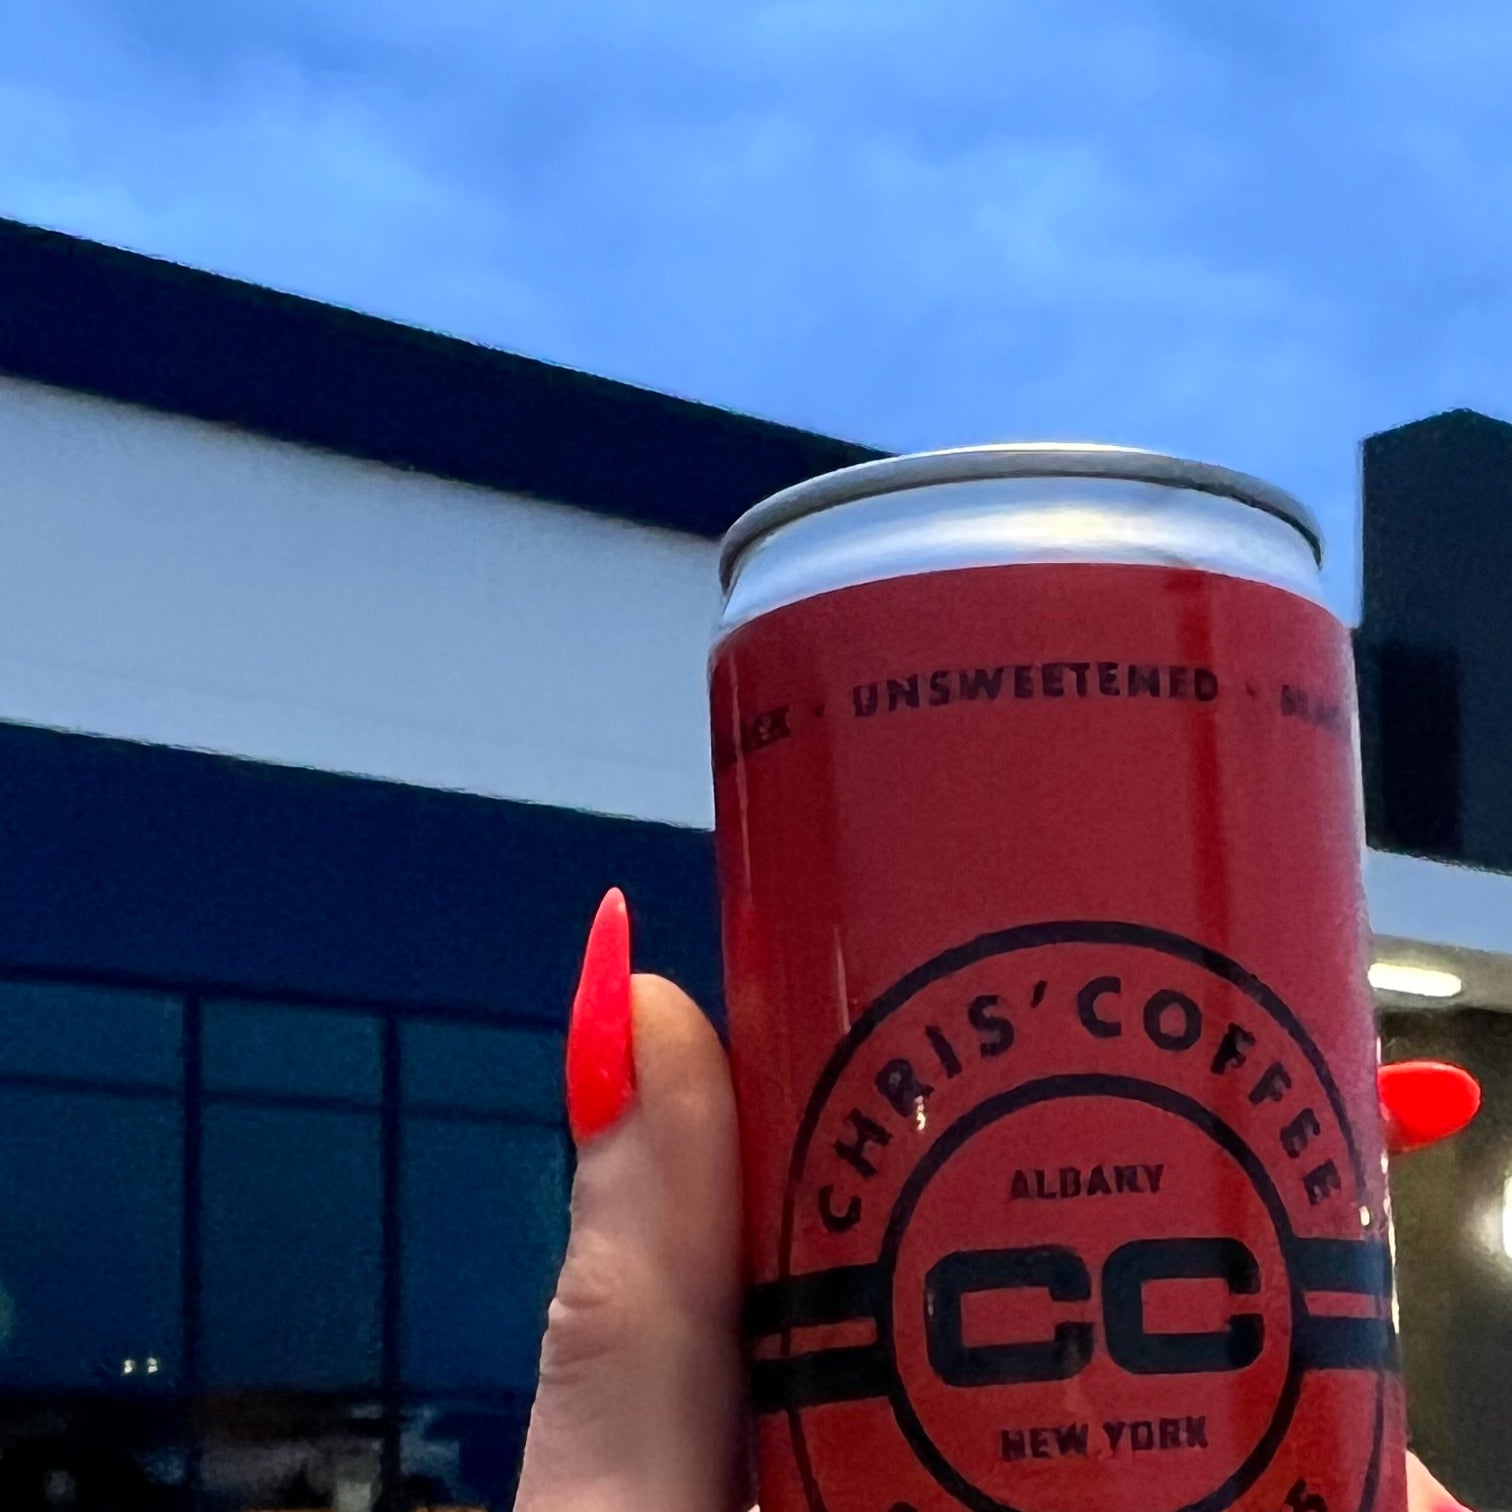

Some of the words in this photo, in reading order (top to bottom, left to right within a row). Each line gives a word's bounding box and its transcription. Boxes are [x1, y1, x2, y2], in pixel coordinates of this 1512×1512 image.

[852, 661, 1219, 718] UNSWEETENED
[1076, 975, 1343, 1207] COFFEE
[1010, 1163, 1165, 1200] ALBANY
[923, 1236, 1266, 1388] CC
[1001, 1423, 1089, 1462] NEW
[1102, 1415, 1209, 1451] YORK
